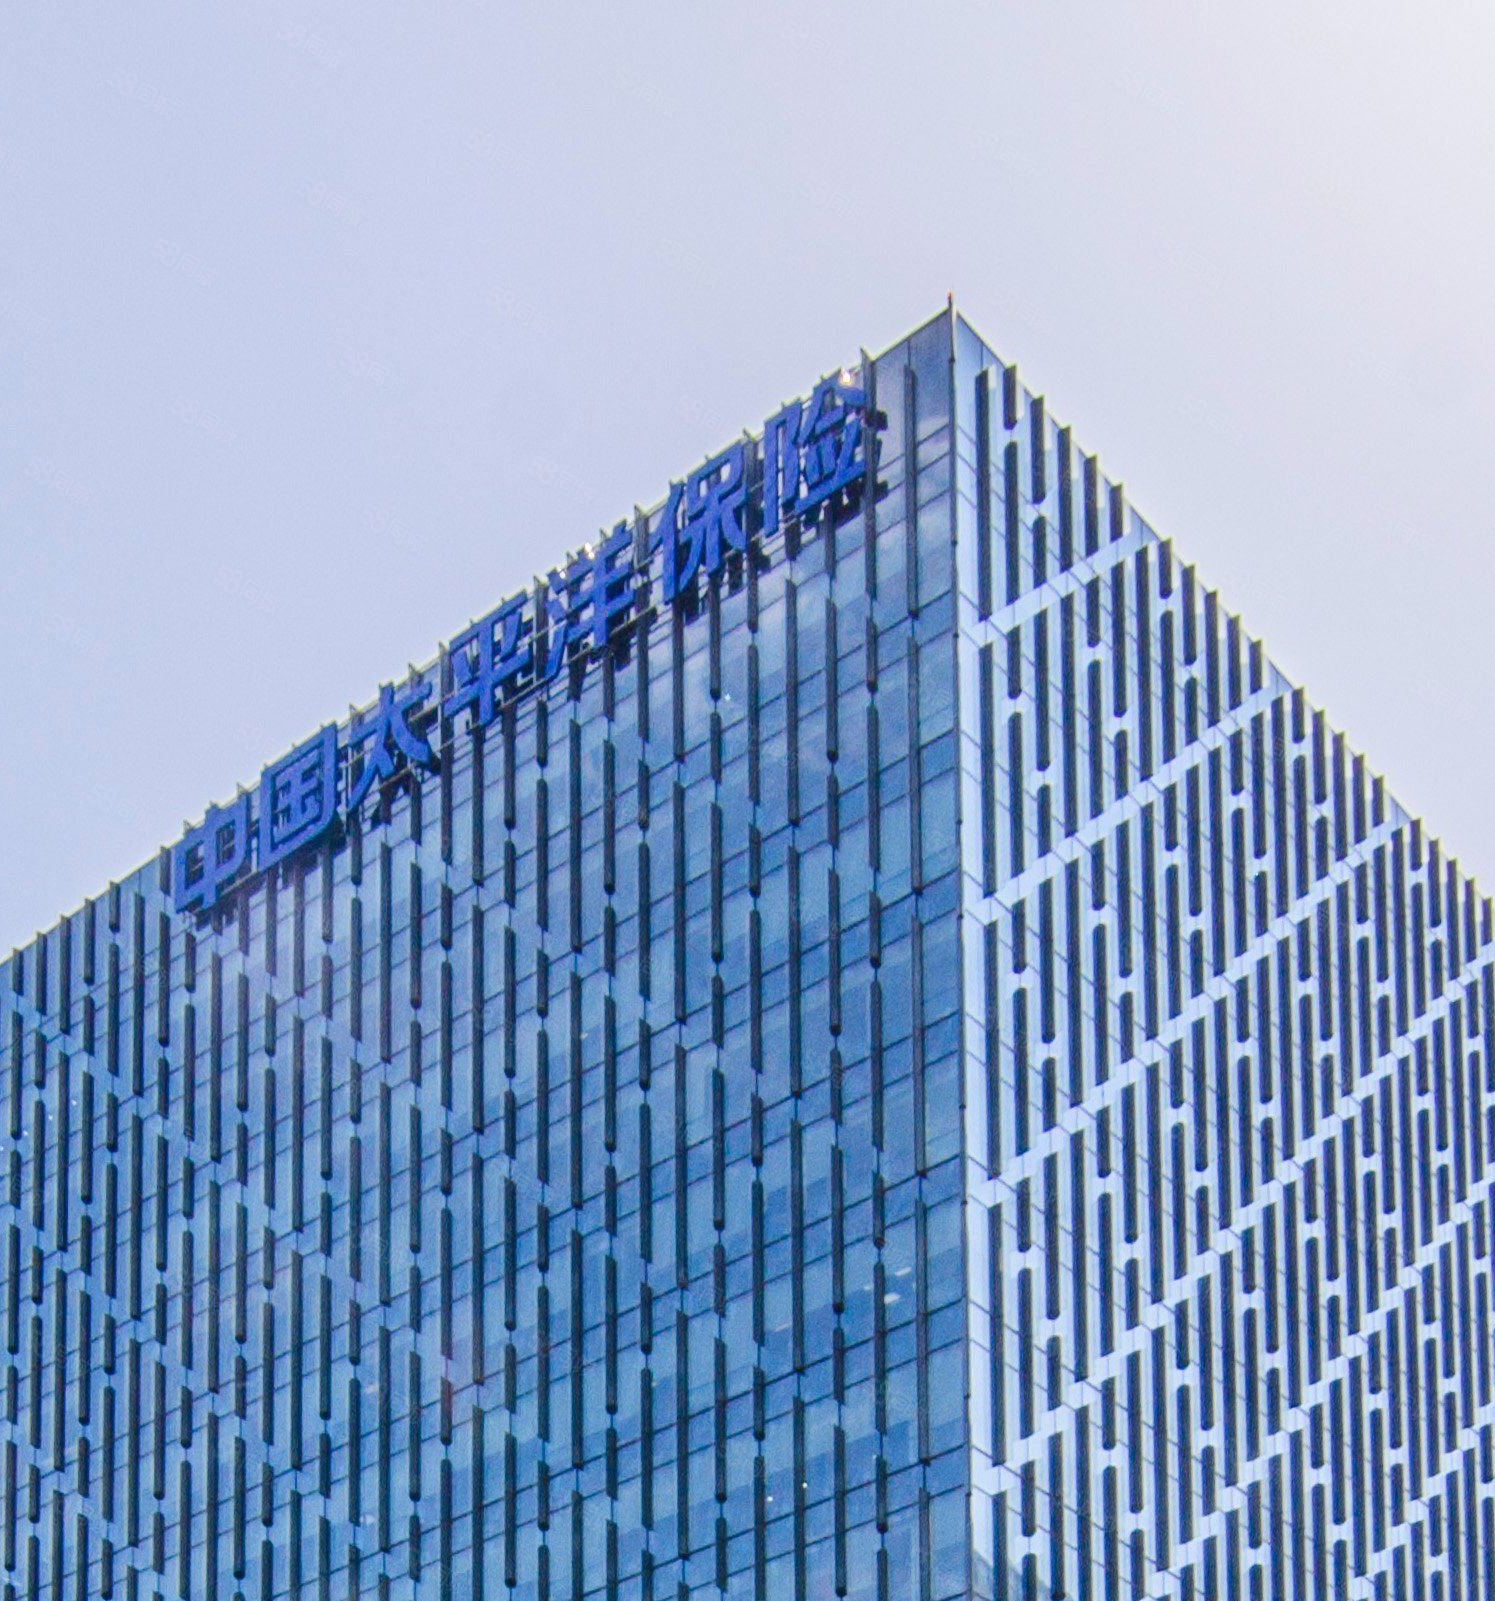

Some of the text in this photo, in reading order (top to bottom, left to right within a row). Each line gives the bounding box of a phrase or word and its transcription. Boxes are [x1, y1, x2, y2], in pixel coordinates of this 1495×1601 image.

[172, 372, 871, 912] 中国太平洋保险
